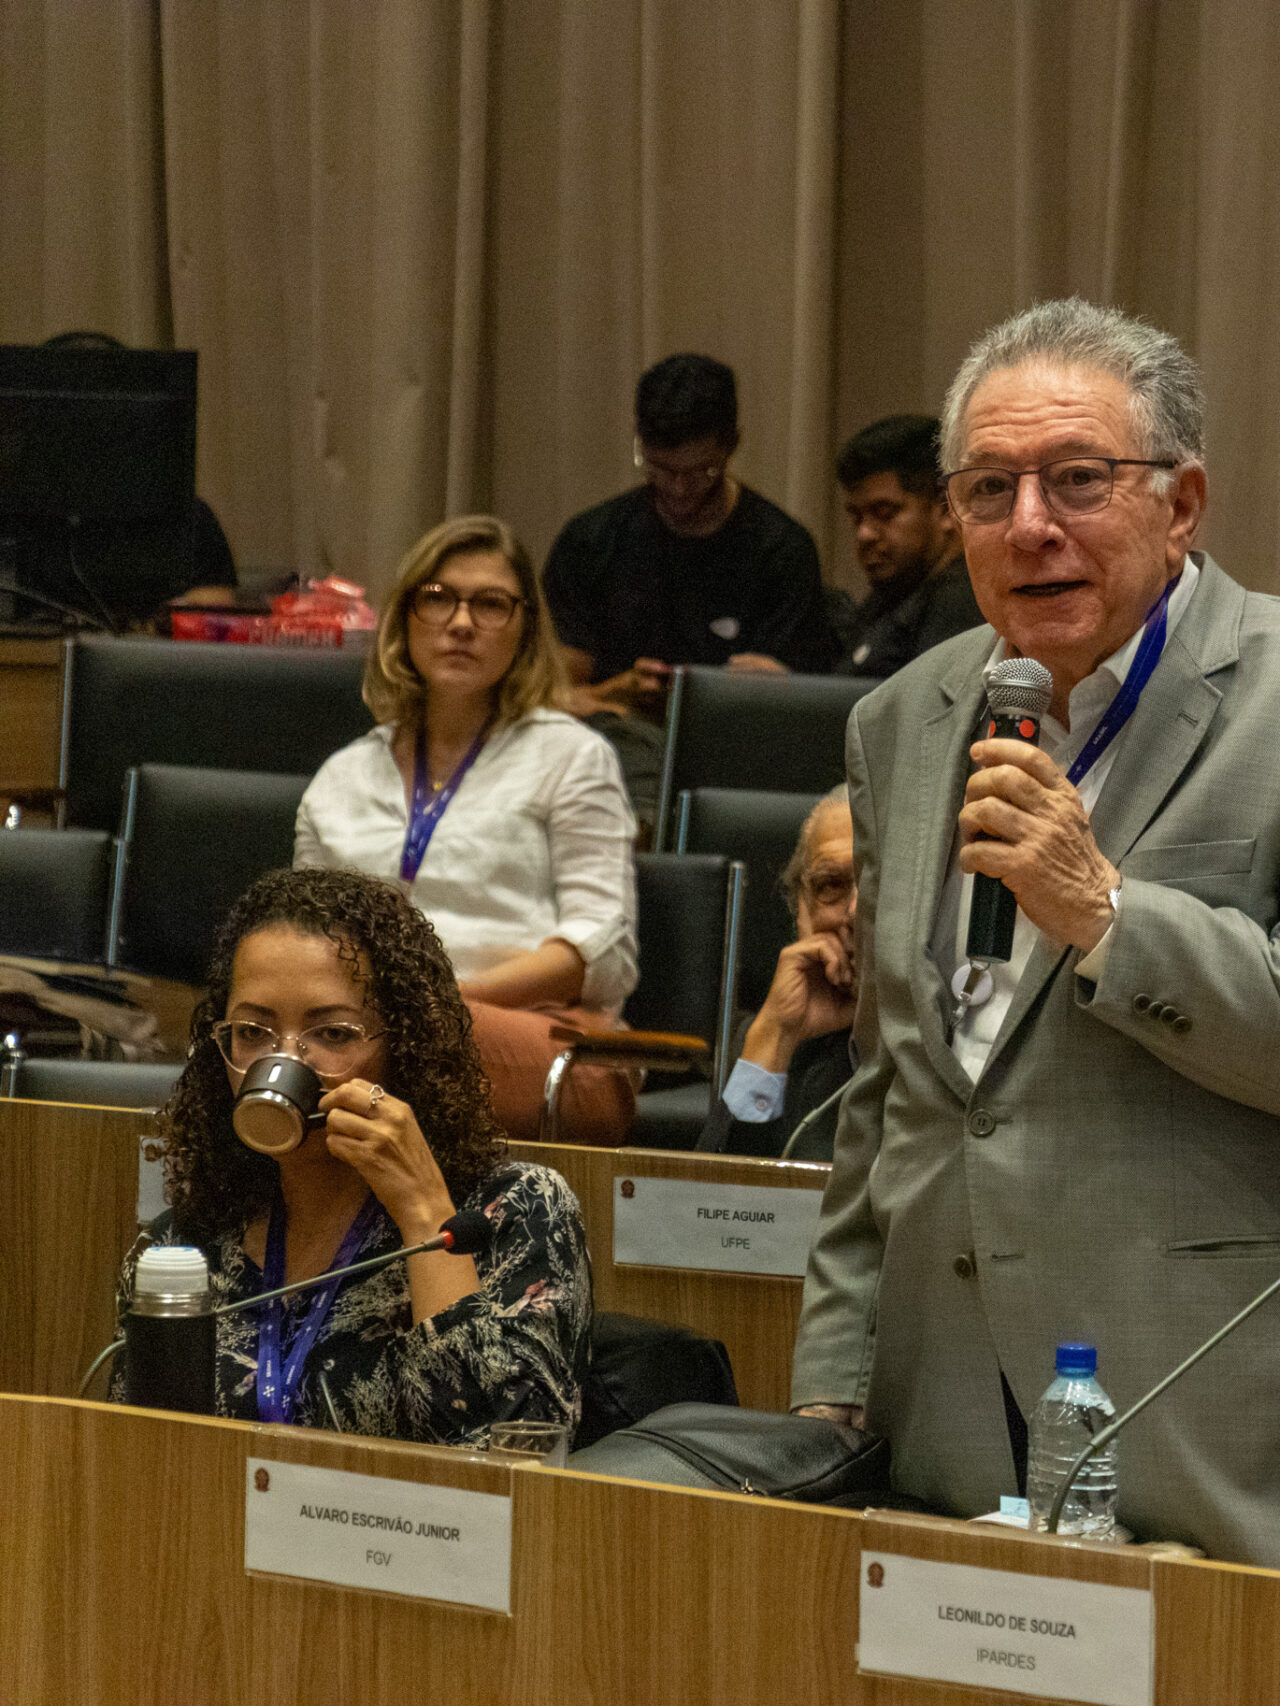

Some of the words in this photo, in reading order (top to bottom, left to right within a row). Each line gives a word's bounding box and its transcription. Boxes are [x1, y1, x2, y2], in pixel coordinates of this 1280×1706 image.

[697, 1207, 730, 1220] FILIPE
[732, 1210, 775, 1223] AGUIAR
[721, 1237, 750, 1250] UFPE
[299, 1504, 349, 1525] ALVARO
[352, 1512, 412, 1535] ESCRIVÃO
[415, 1522, 460, 1542] JUNIOR
[366, 1549, 392, 1567] FGV
[938, 1605, 1005, 1628] LEONILDO
[1009, 1616, 1026, 1632] DE
[1030, 1619, 1076, 1639] SOUZA
[976, 1649, 1036, 1671] IPARDES
